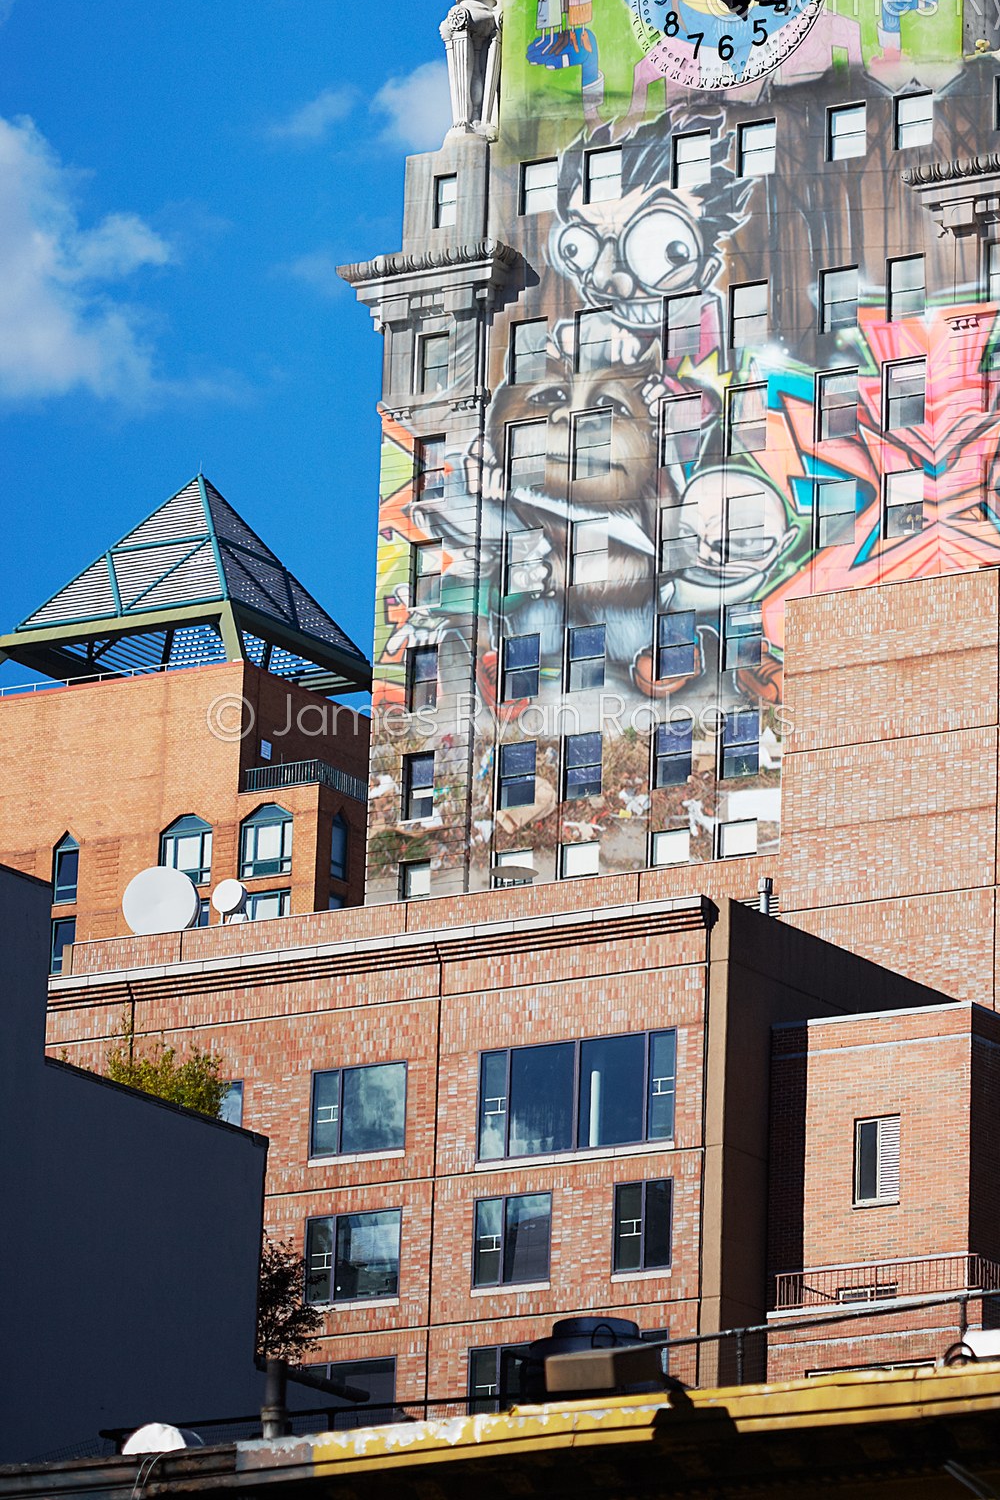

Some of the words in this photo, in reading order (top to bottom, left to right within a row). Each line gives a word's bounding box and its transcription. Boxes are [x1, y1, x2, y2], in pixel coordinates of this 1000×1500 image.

[664, 11, 680, 38] 8
[751, 19, 768, 46] 5
[687, 32, 704, 60] 7
[718, 35, 734, 61] 6
